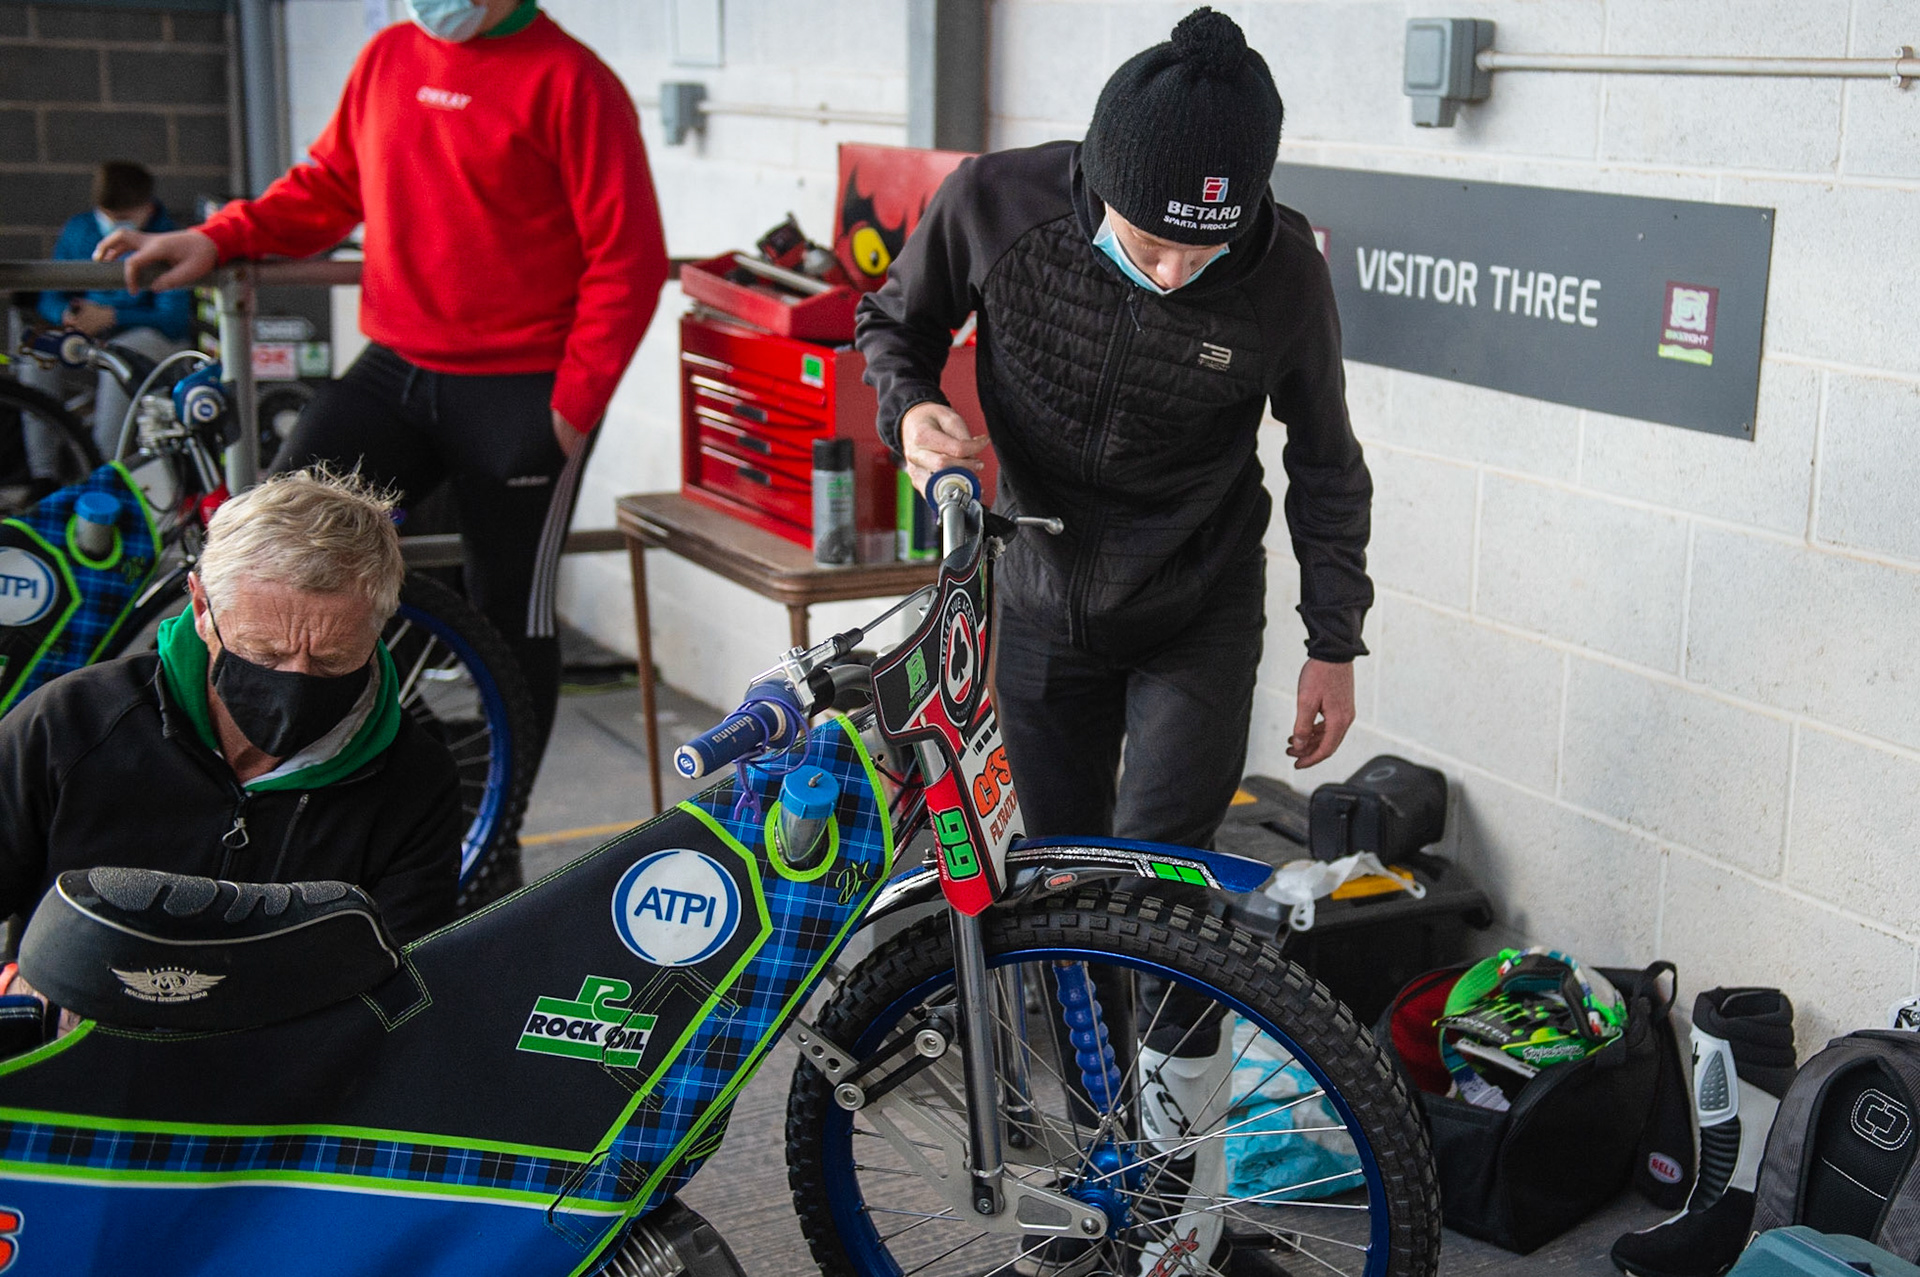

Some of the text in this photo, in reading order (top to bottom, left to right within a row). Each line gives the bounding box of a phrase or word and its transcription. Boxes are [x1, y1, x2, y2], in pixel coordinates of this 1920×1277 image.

[1163, 214, 1198, 230] SPARTA
[1167, 200, 1241, 221] BETARD
[1356, 246, 1602, 327] VISITOR THREE
[0, 572, 39, 599] TPI
[711, 714, 756, 744] domino
[633, 886, 717, 928] ATPI
[526, 1013, 645, 1051] ROCK OIL
[1651, 1157, 1676, 1179] BELL
